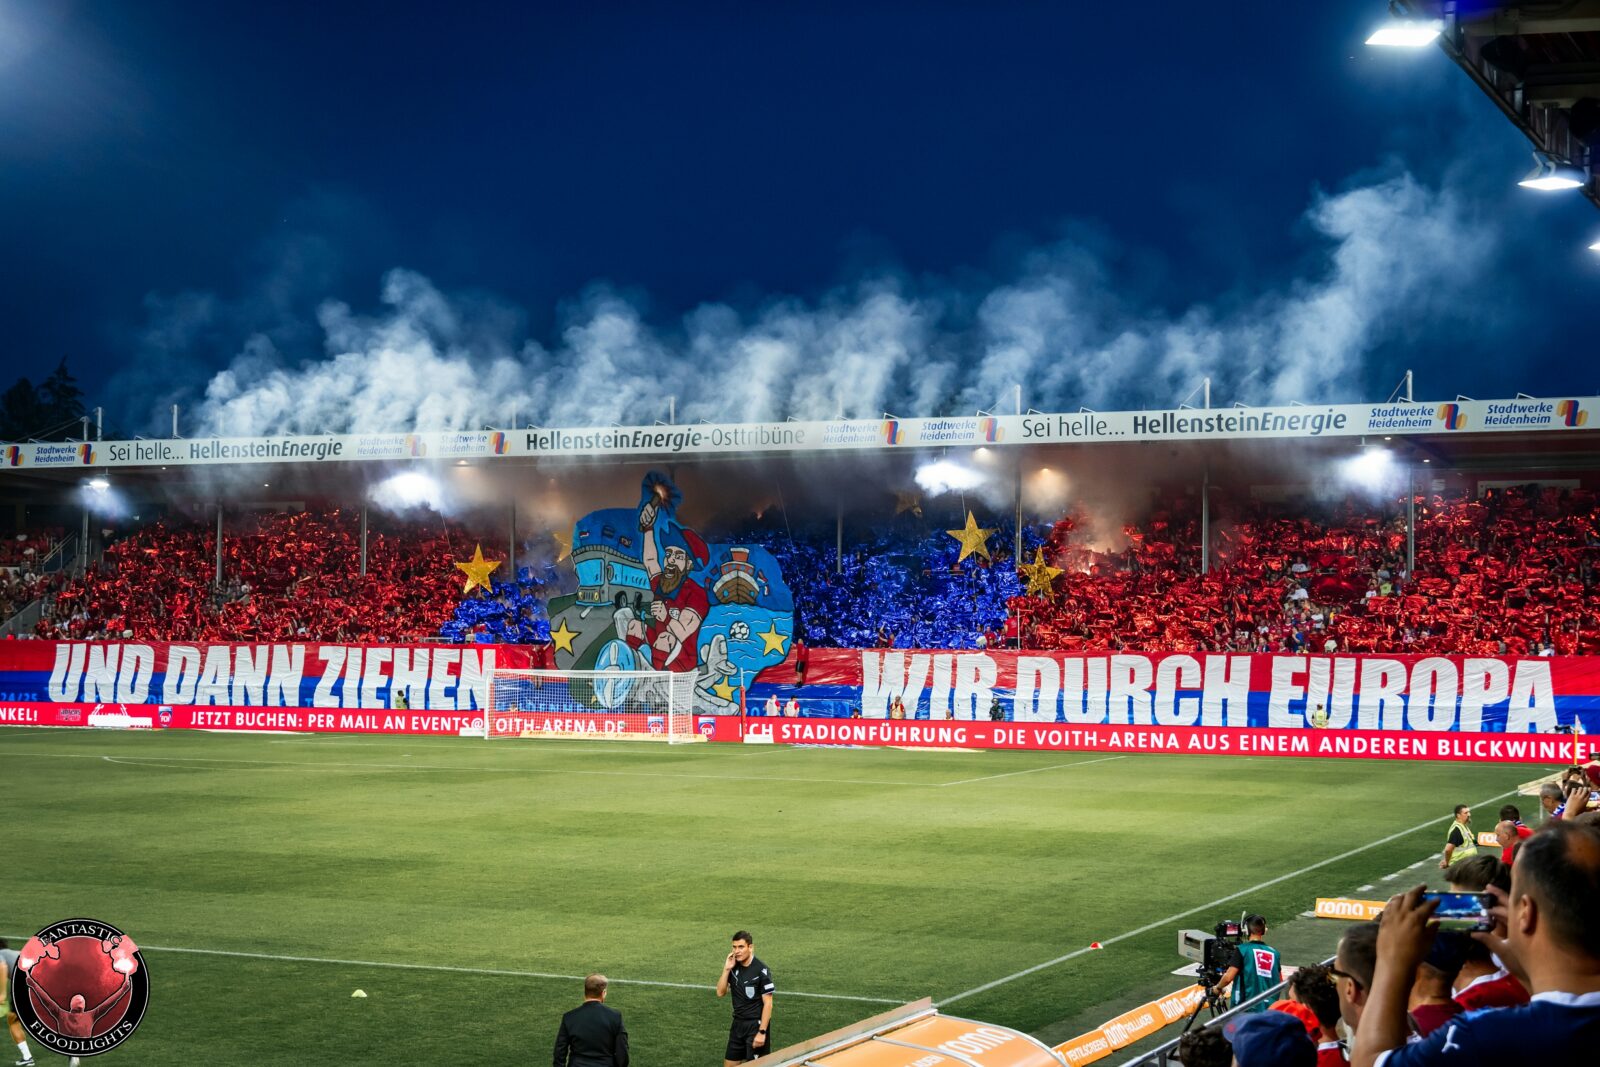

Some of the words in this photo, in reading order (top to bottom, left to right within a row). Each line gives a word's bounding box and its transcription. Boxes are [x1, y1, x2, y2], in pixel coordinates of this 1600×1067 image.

[1371, 406, 1434, 418] Stadtwerke
[1487, 401, 1553, 414] Stadtwerke
[922, 419, 977, 431] Stadtwerke
[1022, 417, 1051, 438] Sei
[1058, 415, 1125, 437] helle...
[1133, 408, 1347, 435] HellensteinEnergie
[1368, 417, 1432, 428] Heidenheim
[1484, 413, 1551, 425] Heidenheim
[825, 422, 878, 434] Stadtwerke
[526, 426, 806, 451] HellensteinEnergie-Osttribüne
[823, 432, 876, 444] Heidenheim
[920, 429, 975, 441] Heidenheim
[36, 445, 77, 455] Stadtwerke
[109, 443, 131, 461] Sei
[136, 442, 184, 461] helle...
[190, 438, 342, 461] HellensteinEnergie
[34, 453, 75, 463] Heidenheim
[48, 643, 154, 704] UND
[162, 644, 305, 707] DANN
[313, 646, 496, 710] ZIEHEN
[861, 651, 997, 721] WIR
[1013, 654, 1251, 728] DURCH
[1268, 656, 1559, 734] EUROPA
[190, 711, 231, 725] JETZT
[235, 712, 303, 727] BUCHEN:
[308, 714, 335, 728] PER
[340, 714, 378, 729] MAIL
[383, 716, 405, 730] AN
[411, 716, 626, 733] EVENTS@OITH-ARENA.DE
[781, 721, 967, 744] STADIONFÜHRUNG
[993, 729, 1026, 745] DIE
[1034, 730, 1177, 749] VOITH-ARENA
[1188, 733, 1230, 750] AUS
[1239, 735, 1309, 752] EINEM
[1319, 736, 1430, 755] ANDEREN
[1317, 901, 1363, 916] roma
